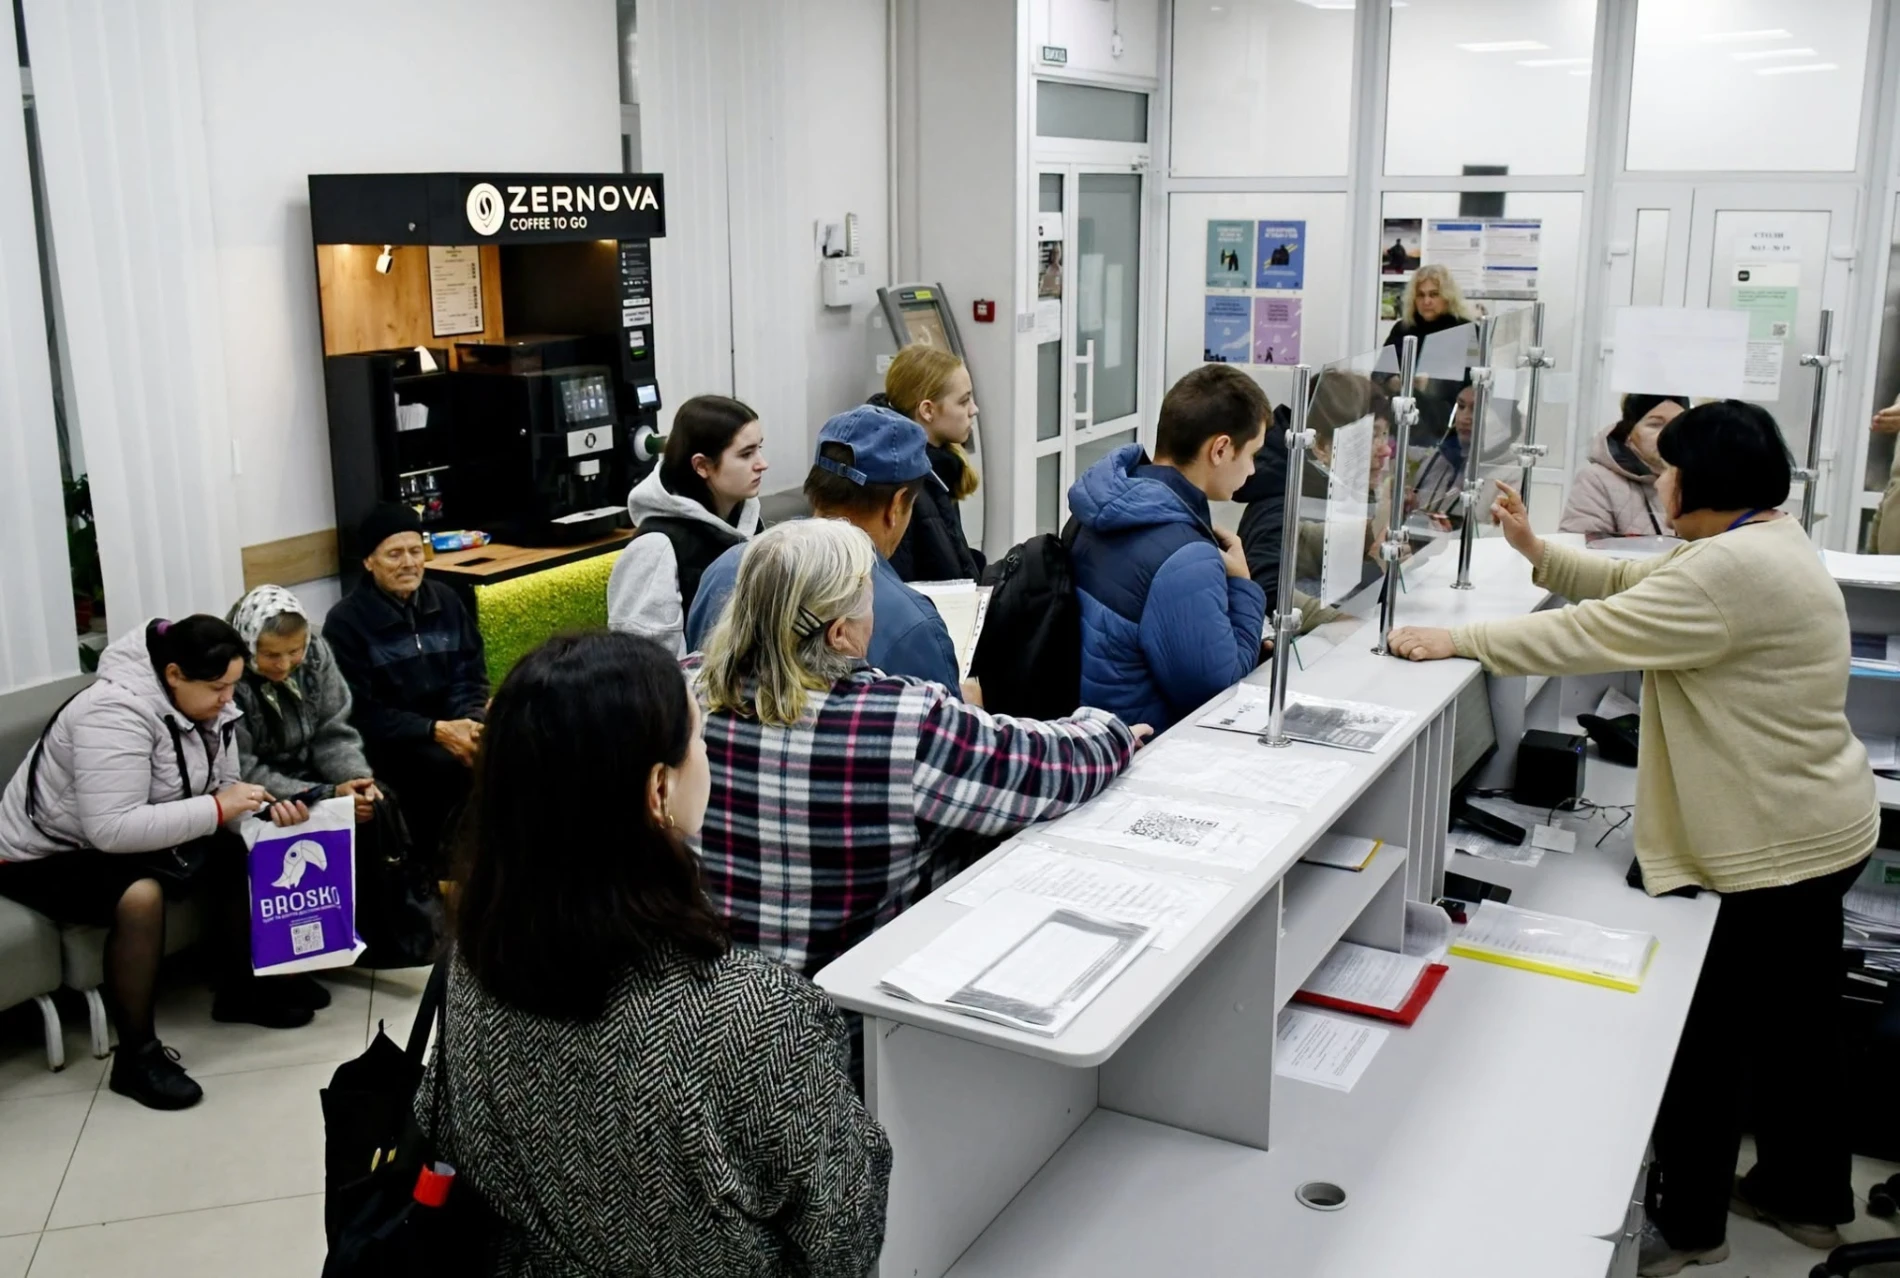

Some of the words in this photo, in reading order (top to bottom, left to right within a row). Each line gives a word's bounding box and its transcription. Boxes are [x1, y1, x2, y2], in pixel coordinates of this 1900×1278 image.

[507, 185, 659, 213] ZERNOVA
[510, 217, 550, 231] COFFEE
[553, 217, 567, 230] TO
[570, 216, 587, 229] GO
[260, 886, 340, 918] BROSKO
